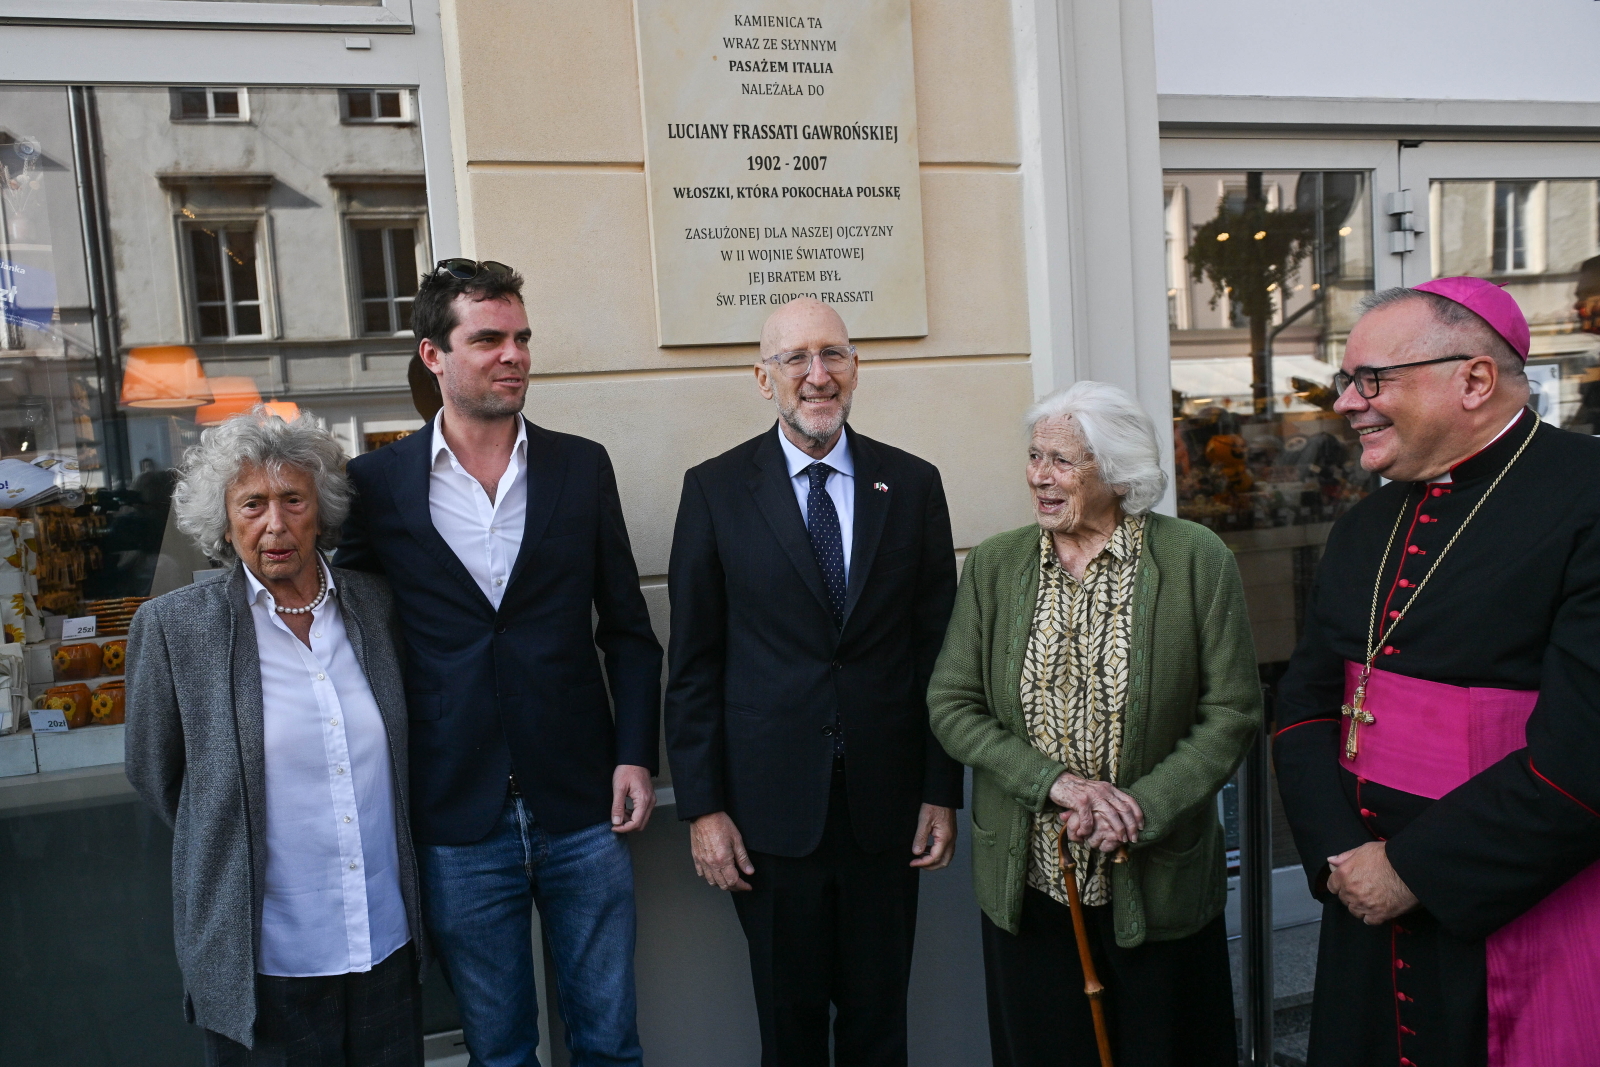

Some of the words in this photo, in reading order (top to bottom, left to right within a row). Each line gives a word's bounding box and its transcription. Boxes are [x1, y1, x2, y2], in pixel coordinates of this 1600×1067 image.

[734, 15, 805, 28] KAMIENICA
[807, 17, 823, 29] TA
[723, 37, 760, 50] WRAZ
[763, 39, 778, 50] ZE
[781, 39, 837, 51] SŁYNNYM
[729, 58, 789, 73] PASAŻEM
[793, 62, 834, 74] ITALIA
[741, 82, 804, 96] NALEŻAŁA
[808, 85, 825, 96] DO
[668, 124, 729, 139] LUCIANY
[733, 124, 798, 140] FRASSATI
[802, 121, 899, 143] GAWROŃSKIEJ
[747, 156, 782, 171] 1902
[793, 156, 828, 171] 2007
[673, 187, 734, 200] WŁOSZKI,
[736, 184, 779, 199] KTÓRA
[782, 187, 854, 198] POKOCHAŁA
[856, 187, 901, 200] POLSKĘ
[685, 226, 760, 241] ZASŁUŻONEJ
[764, 227, 788, 239] DLA
[791, 227, 833, 240] NASZEJ
[836, 226, 894, 239] OJCZYZNY
[721, 250, 733, 262] W
[736, 250, 745, 261] II
[748, 249, 793, 263] WOJNIE
[796, 246, 865, 261] ŚWIATOWEJ
[749, 272, 765, 286] JEJ
[767, 271, 816, 283] BRATEM
[819, 270, 842, 282] BYŁ
[716, 292, 737, 306] ŚW.
[739, 294, 767, 306] PIER
[821, 290, 874, 303] FRASSATI
